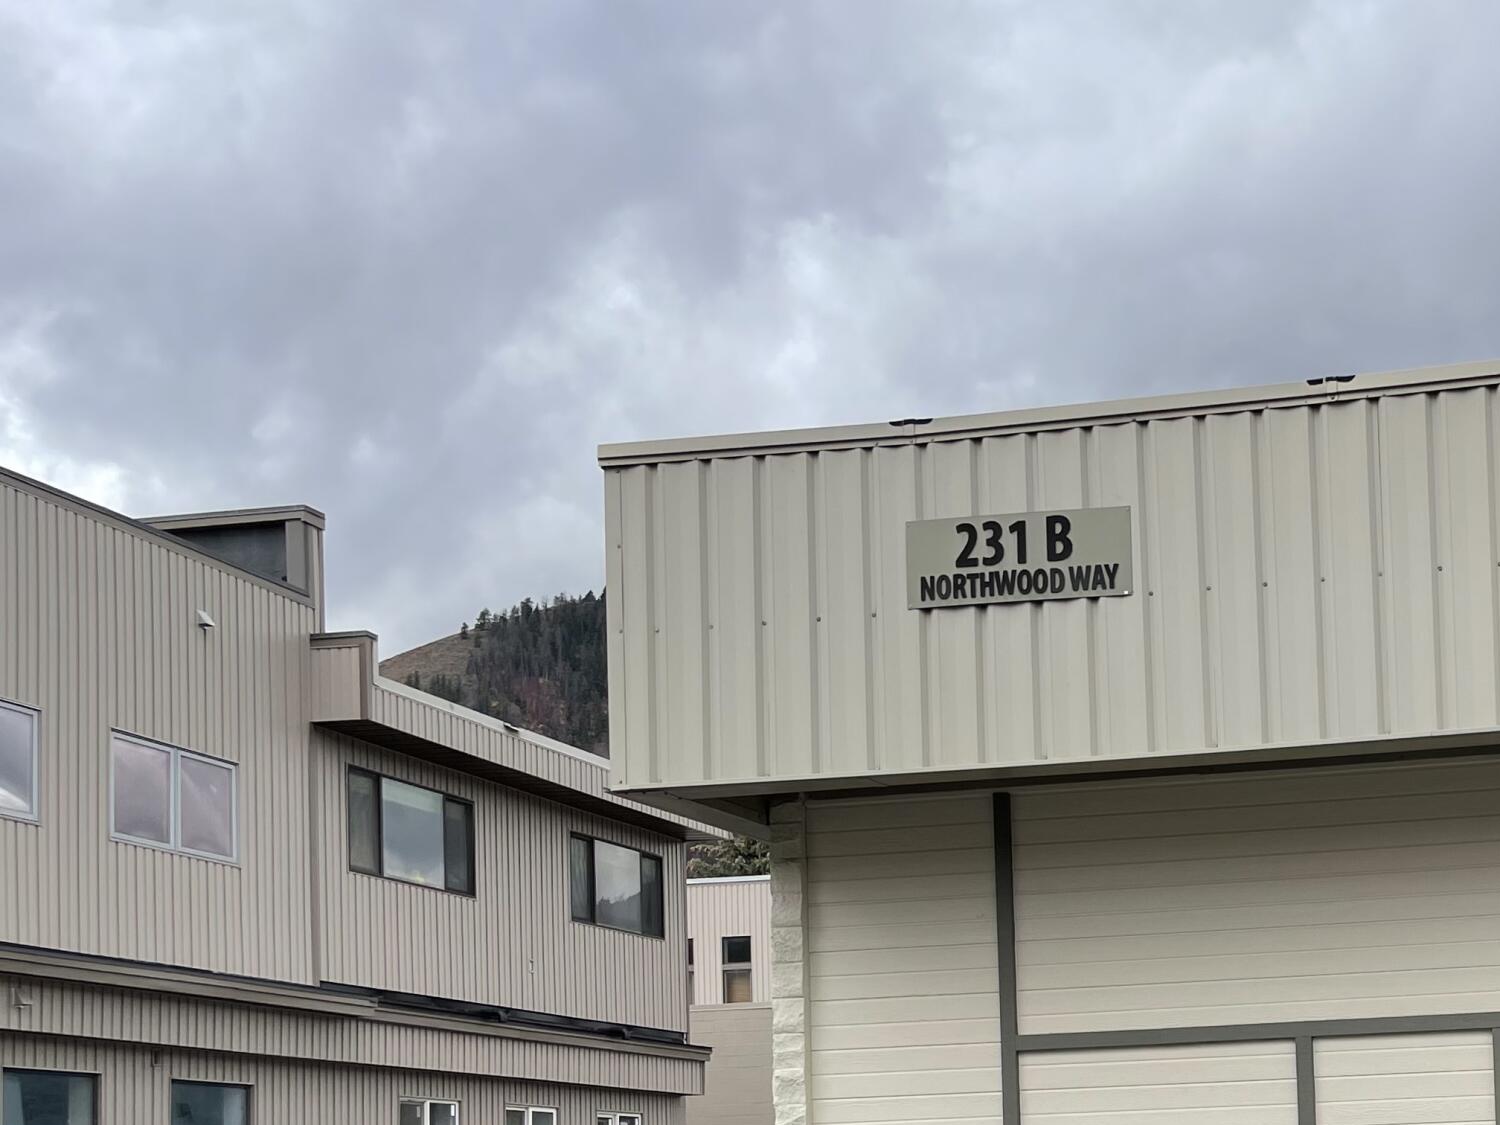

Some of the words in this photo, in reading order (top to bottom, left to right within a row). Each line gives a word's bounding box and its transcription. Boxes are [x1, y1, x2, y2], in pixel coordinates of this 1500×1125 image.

[955, 520, 1027, 568] 231
[1045, 514, 1073, 562] B
[920, 568, 1065, 602] NORTHWOOD
[1068, 563, 1119, 592] WAY
